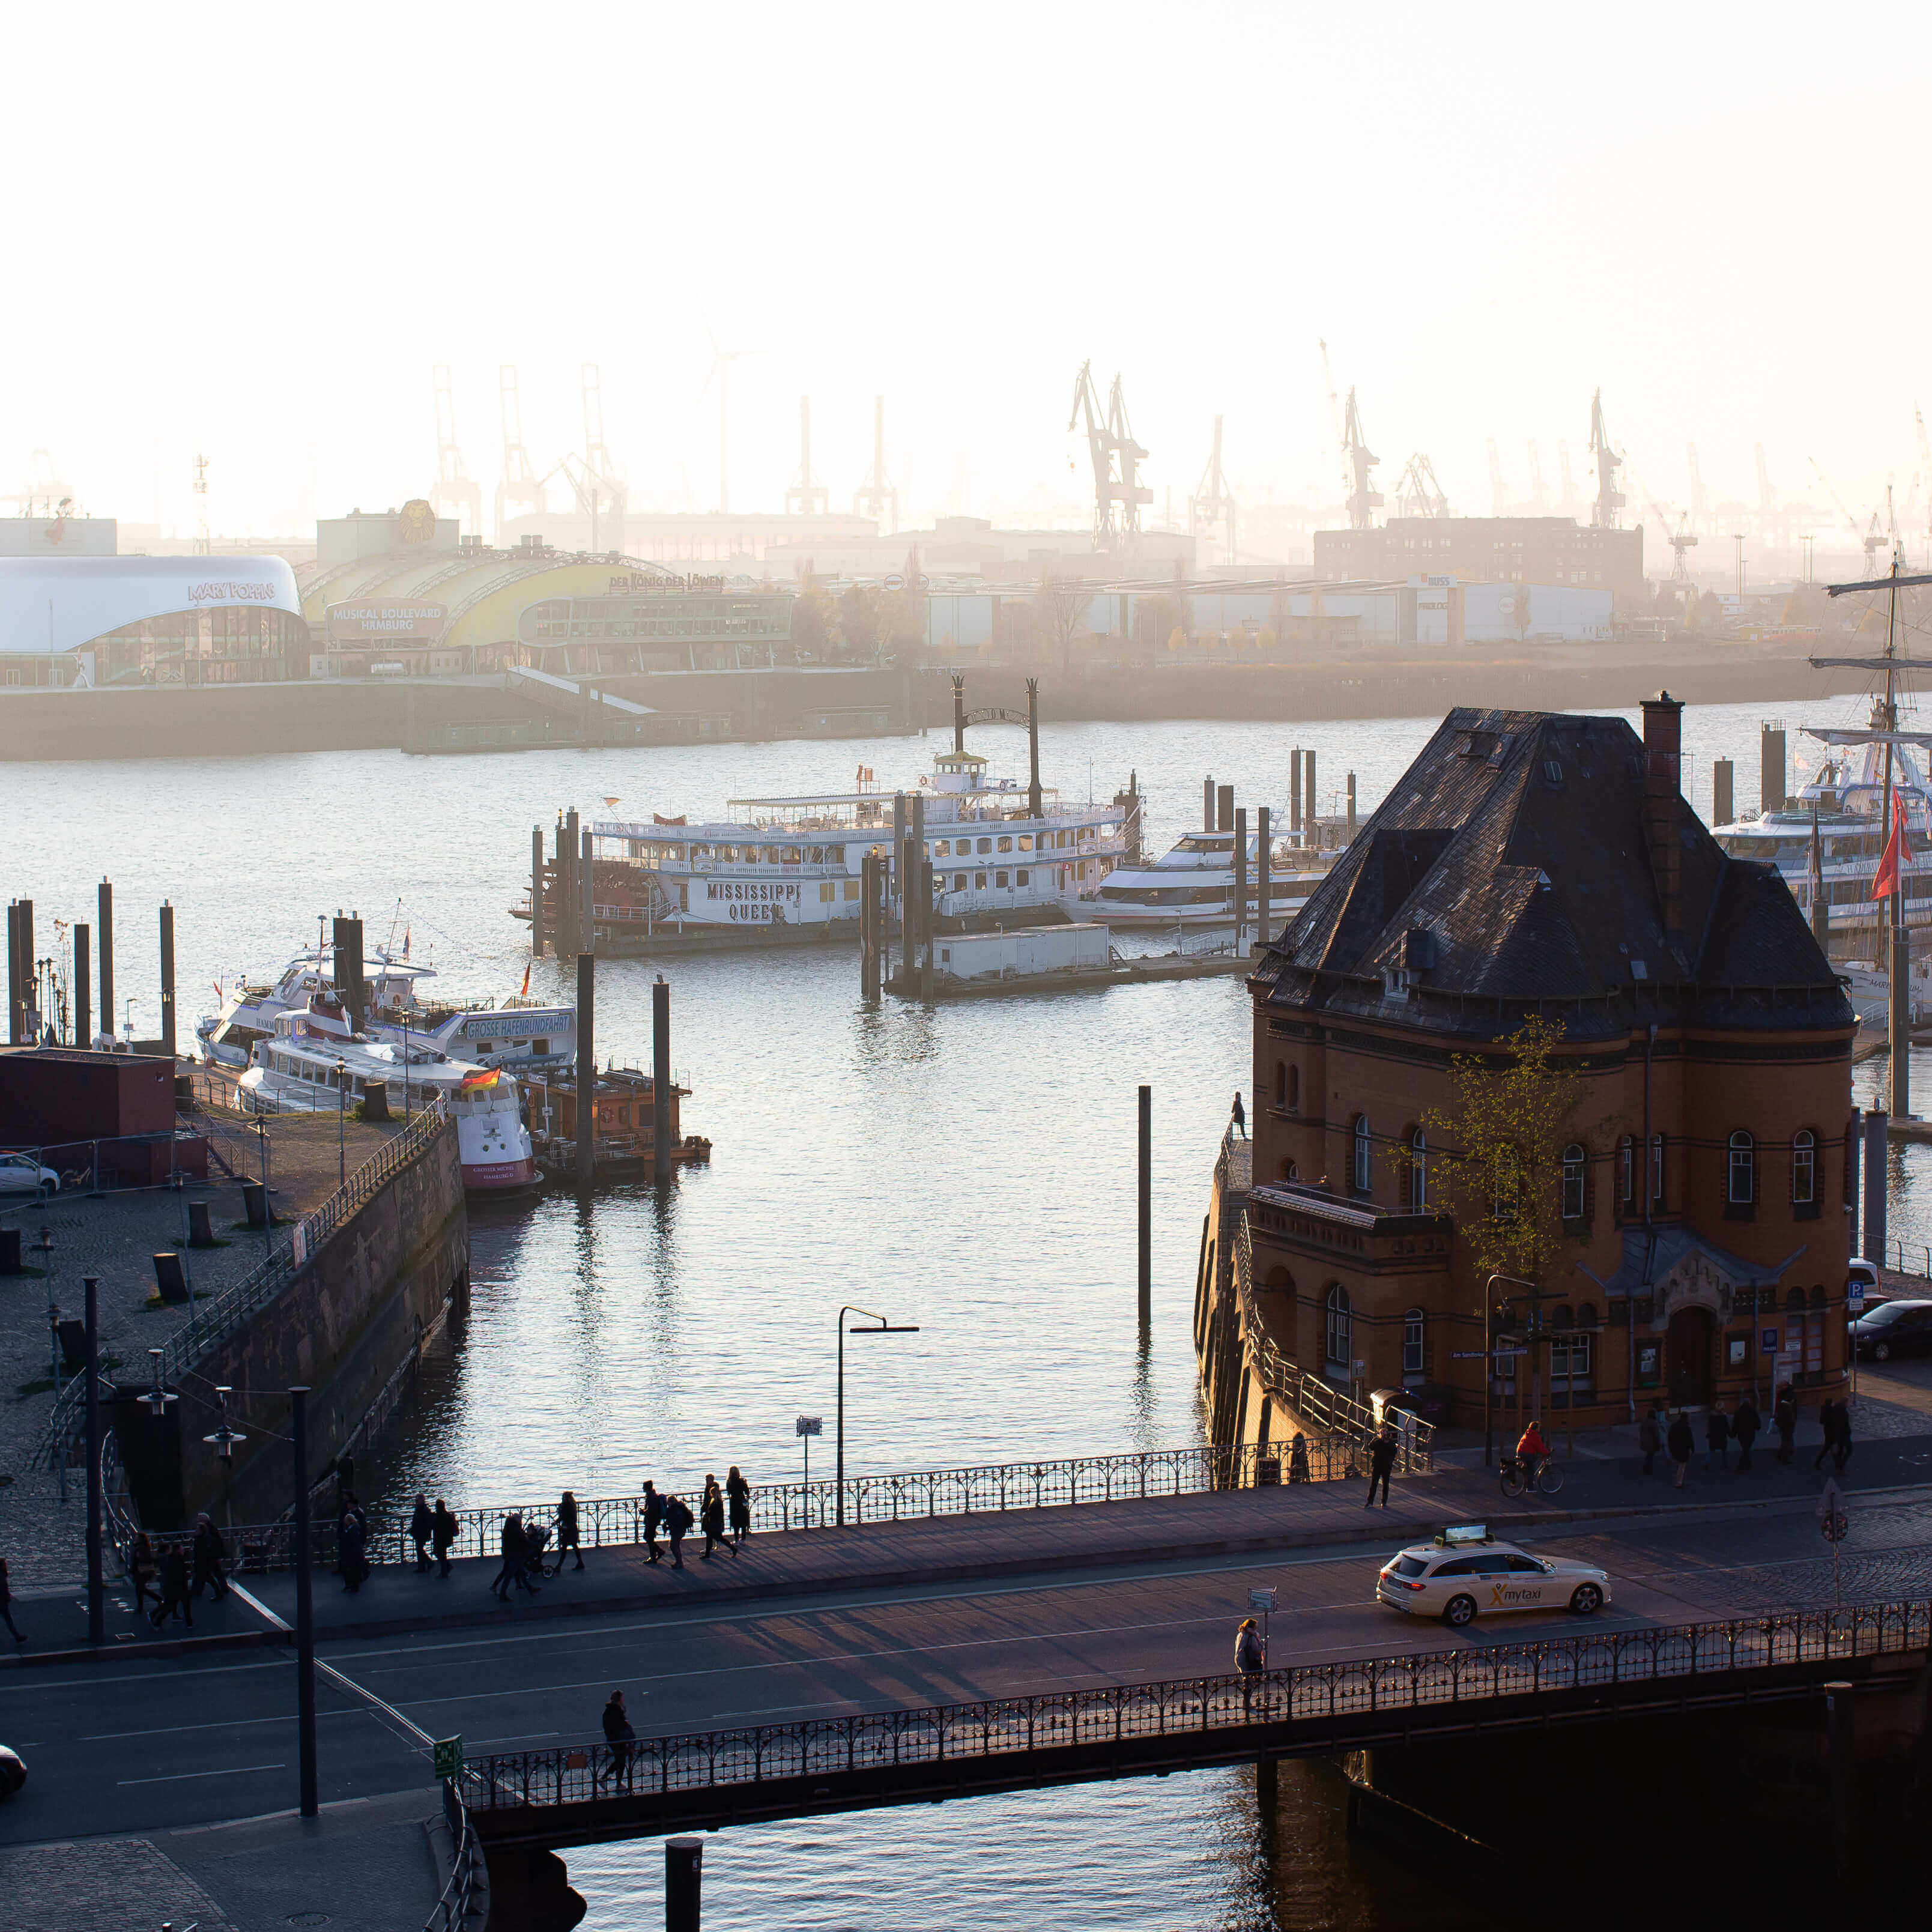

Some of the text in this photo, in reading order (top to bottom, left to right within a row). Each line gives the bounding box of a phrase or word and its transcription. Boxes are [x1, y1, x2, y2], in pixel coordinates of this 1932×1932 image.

[610, 572, 724, 591] DER KÖNIG DER LÖWEN
[189, 581, 275, 601] MARY POPPINS
[333, 607, 442, 620] MUSICAL BOULEVARD
[362, 619, 413, 630] HAMBURG
[707, 883, 801, 901] MISSISSIPPI
[730, 903, 775, 922] QUEE
[468, 1016, 569, 1038] GROSSE HAFENRUNDFAHRT
[1853, 1284, 1861, 1297] P
[1504, 1587, 1542, 1603] mytaxi
